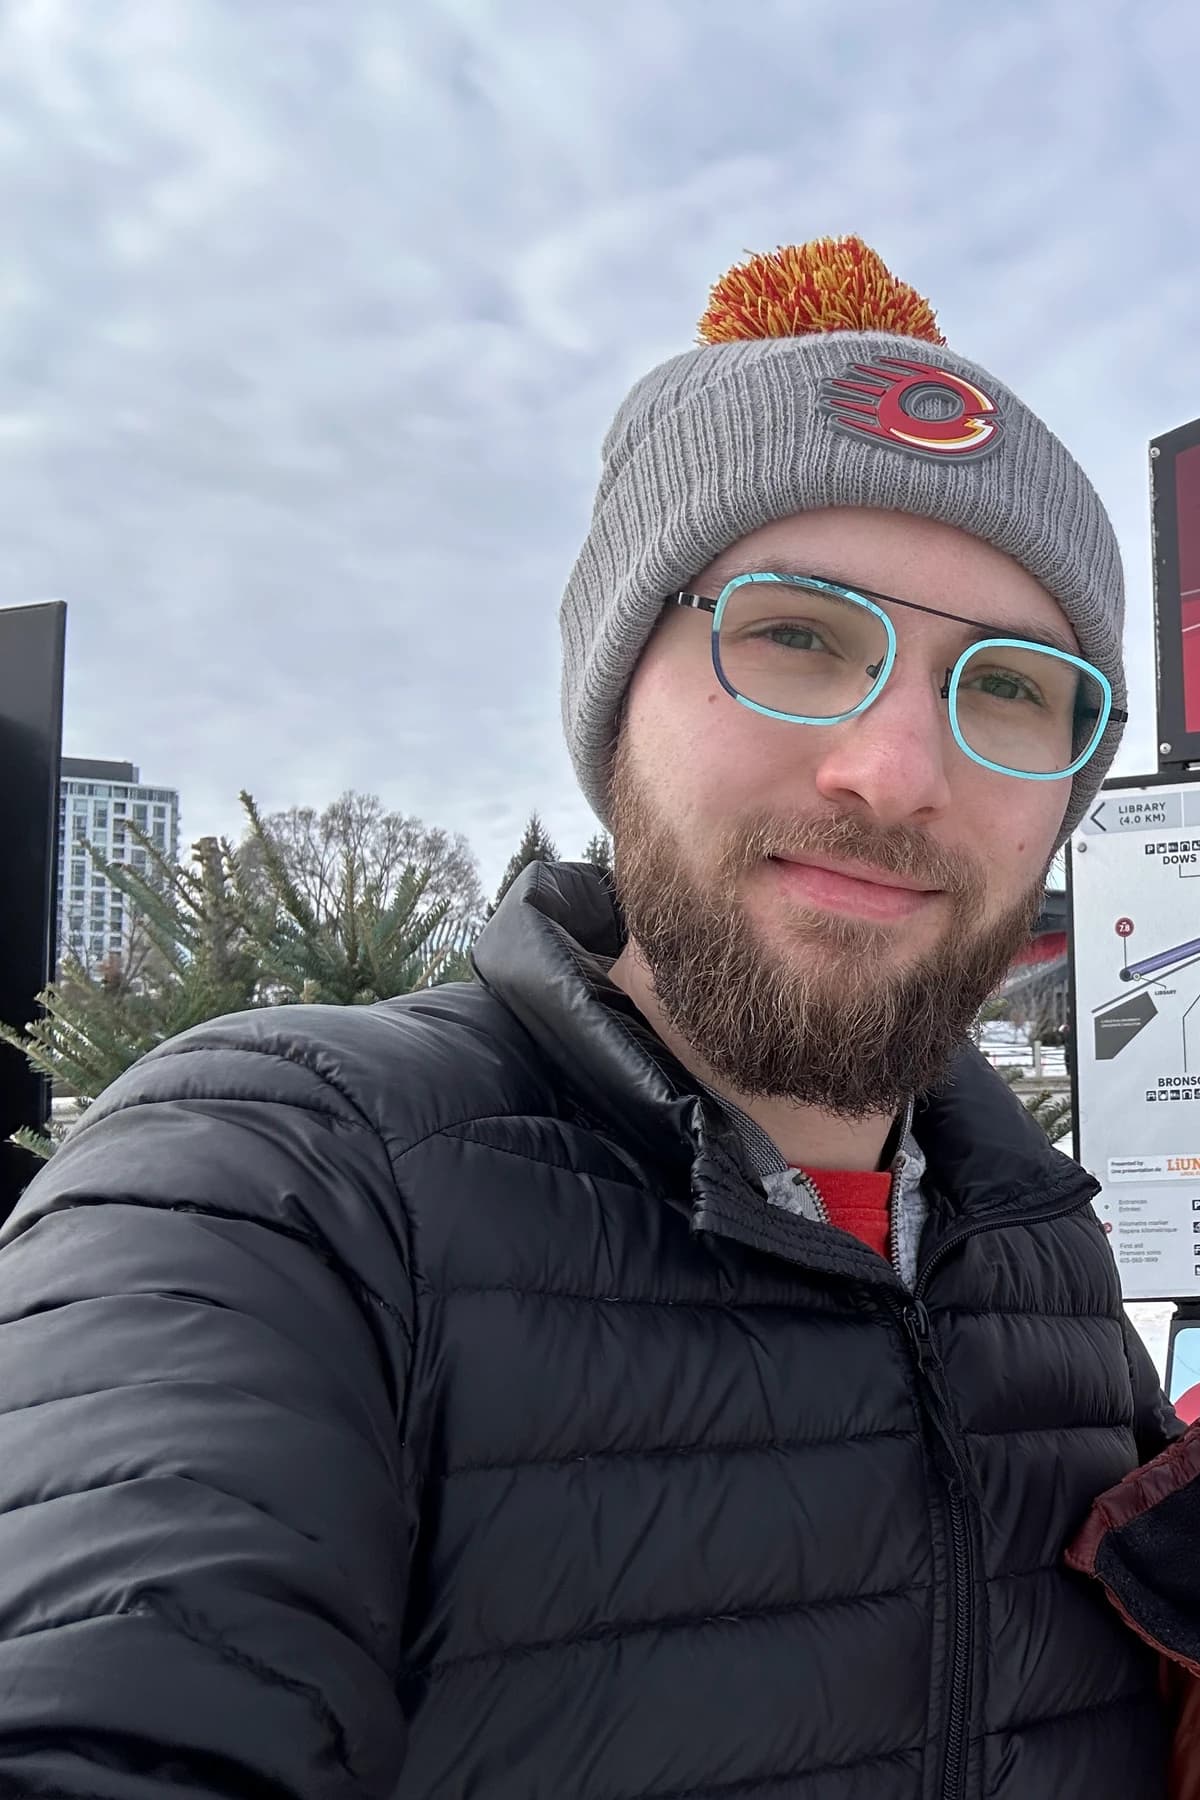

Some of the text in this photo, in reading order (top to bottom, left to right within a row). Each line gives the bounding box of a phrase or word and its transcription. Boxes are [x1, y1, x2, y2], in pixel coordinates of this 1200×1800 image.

[1118, 801, 1166, 814] LIBRARY
[1119, 812, 1166, 826] (4.0 KM)
[1162, 854, 1197, 865] DOWS
